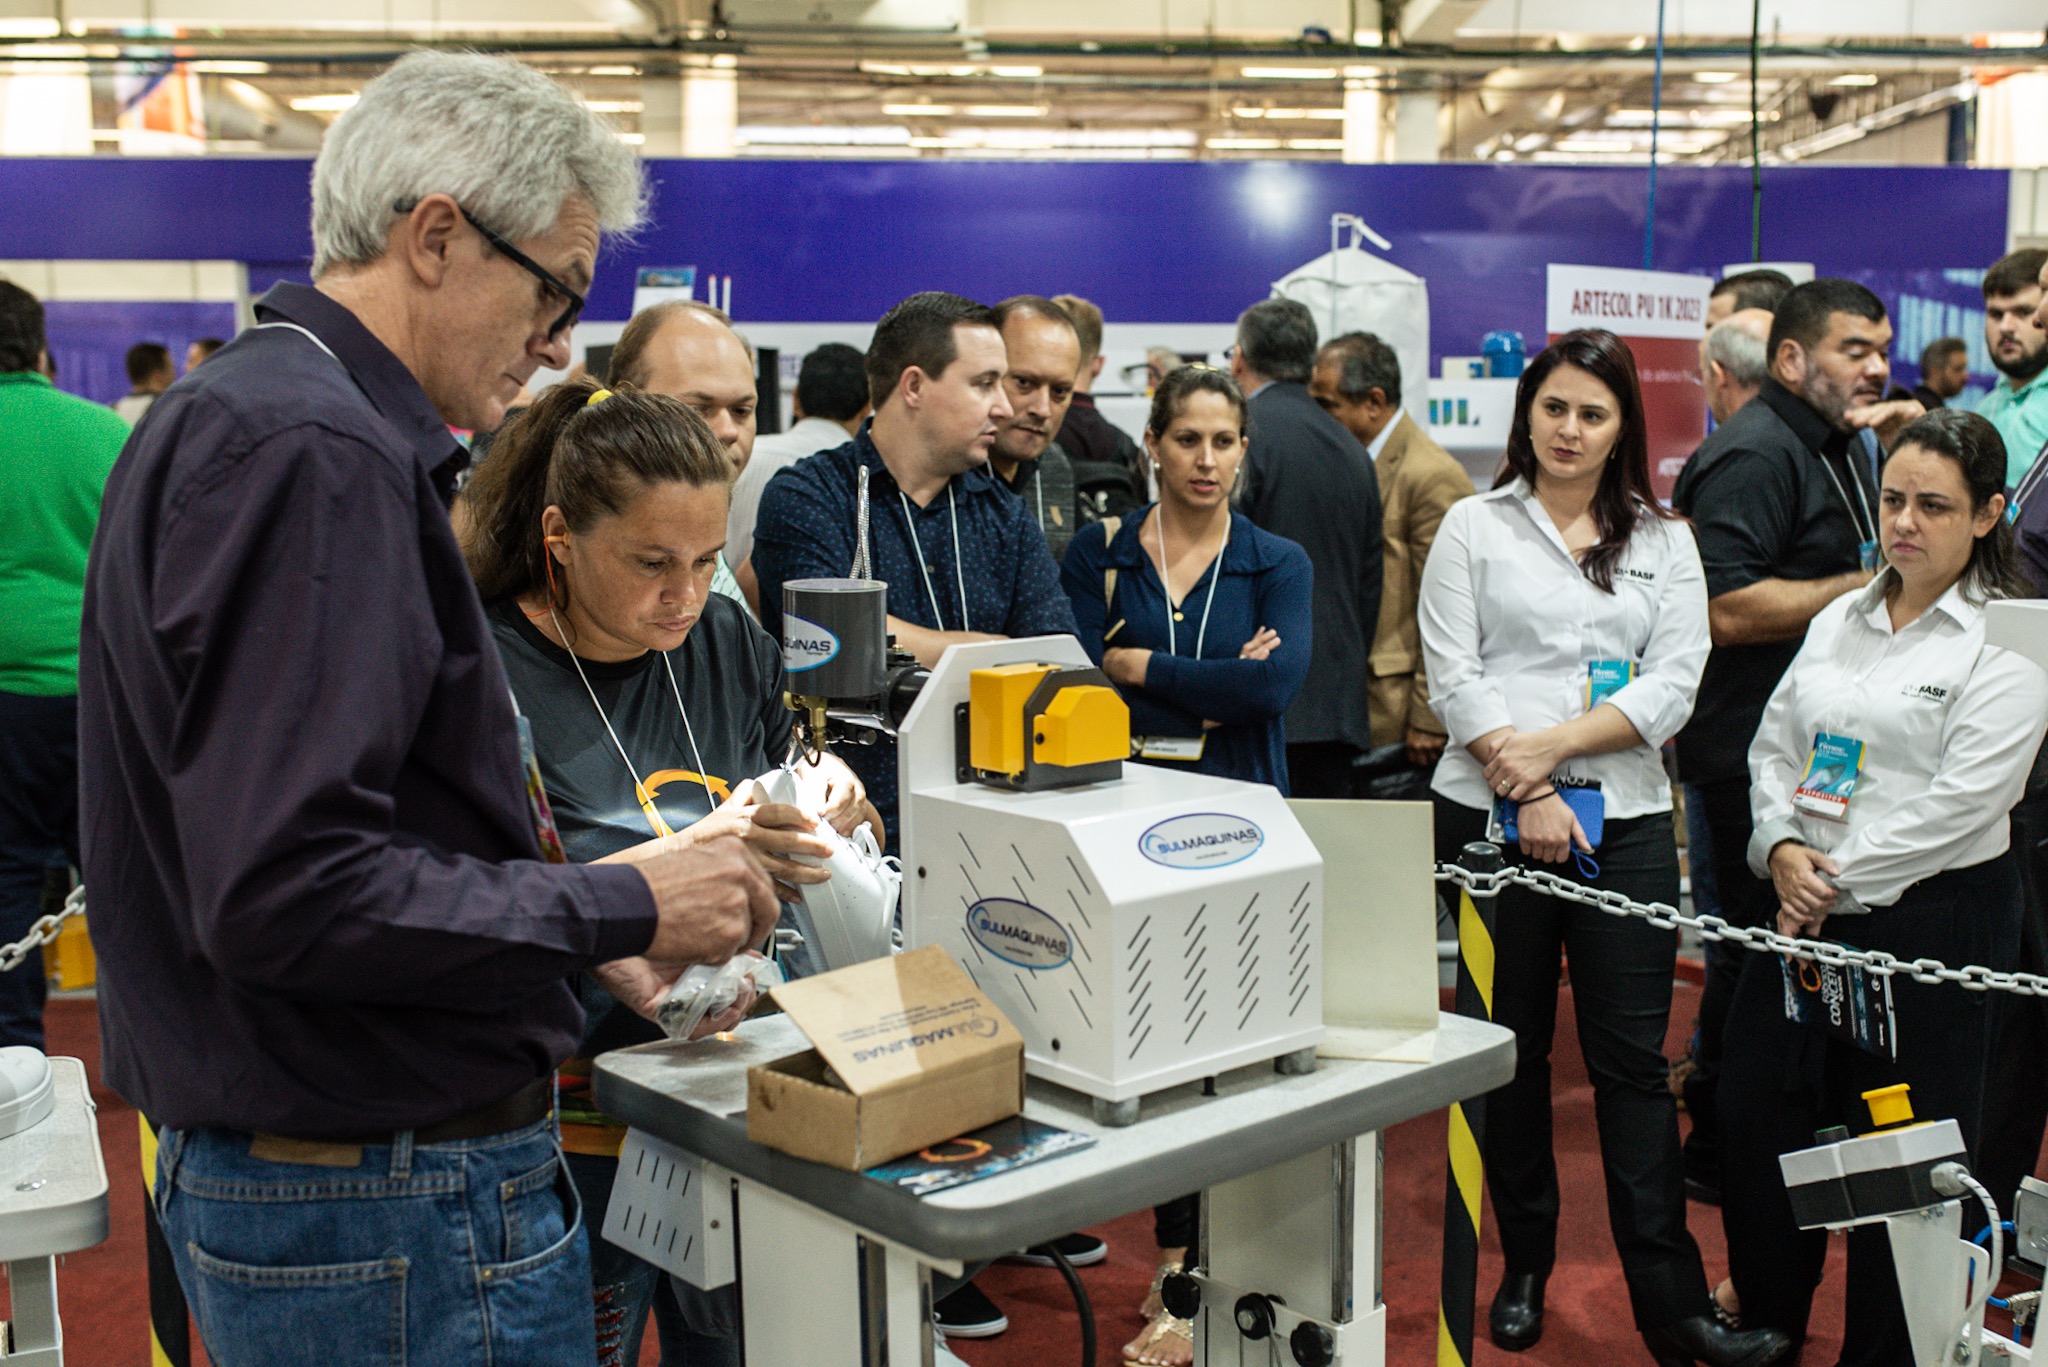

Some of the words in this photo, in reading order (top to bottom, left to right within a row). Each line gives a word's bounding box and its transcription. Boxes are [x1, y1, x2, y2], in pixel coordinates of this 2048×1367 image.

[1571, 289, 1633, 318] ARTECOL
[1637, 293, 1655, 318] PU
[1826, 964, 1842, 1027] CONCEIT
